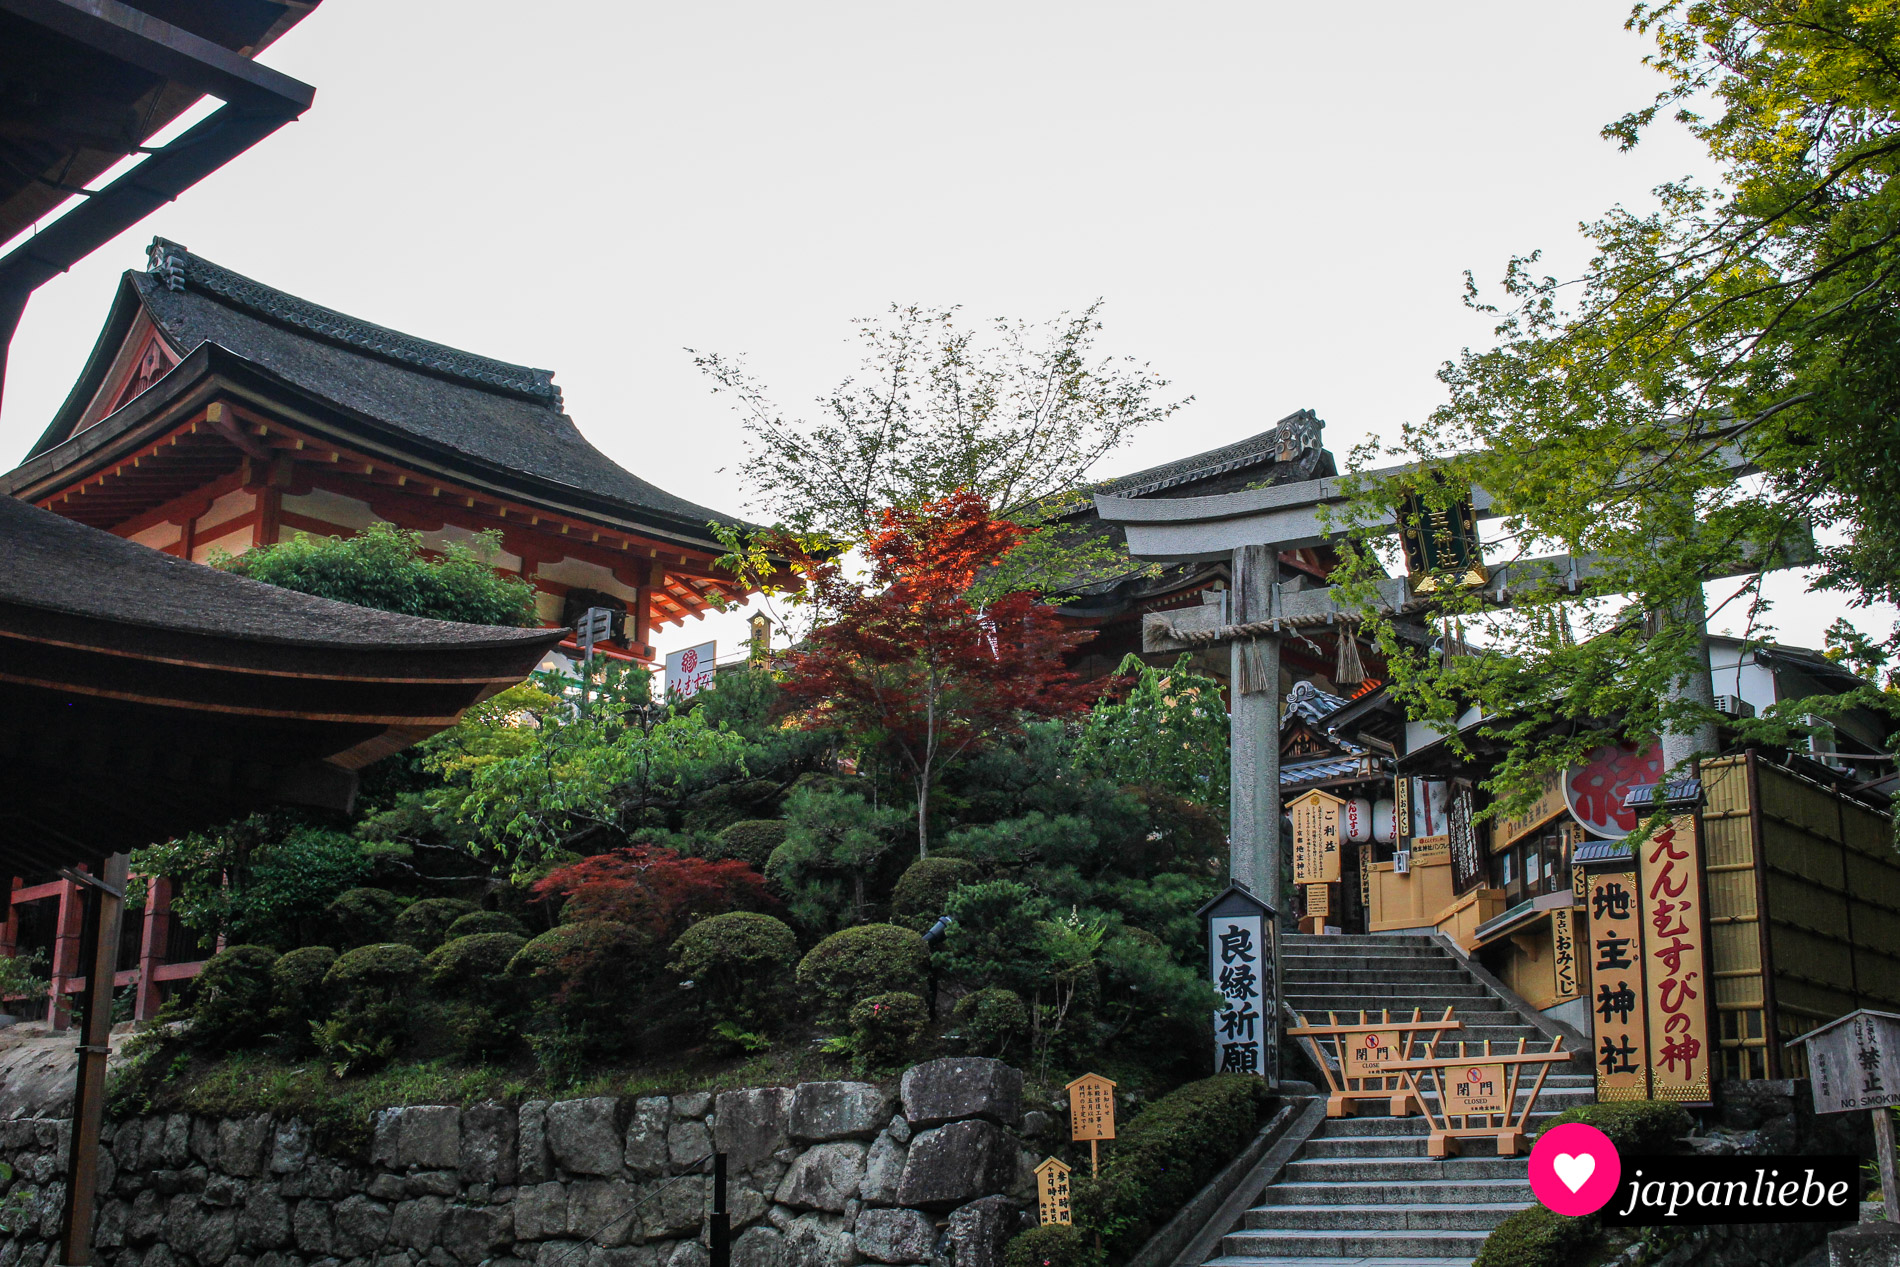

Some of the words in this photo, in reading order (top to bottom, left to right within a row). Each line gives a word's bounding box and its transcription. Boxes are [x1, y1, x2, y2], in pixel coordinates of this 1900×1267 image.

[1324, 810, 1336, 852] ご利益
[1556, 910, 1575, 994] 恋占いおみくじ
[1649, 823, 1701, 1081] えんむすびの神
[1218, 924, 1260, 1076] 良縁祈願
[1592, 882, 1640, 1076] 地主神社
[1456, 1081, 1493, 1097] 閉門
[1858, 1046, 1884, 1093] 禁止
[1841, 1098, 1856, 1108] NO
[1860, 1094, 1900, 1106] SMOKIN
[1057, 1170, 1070, 1222] 参拝時間
